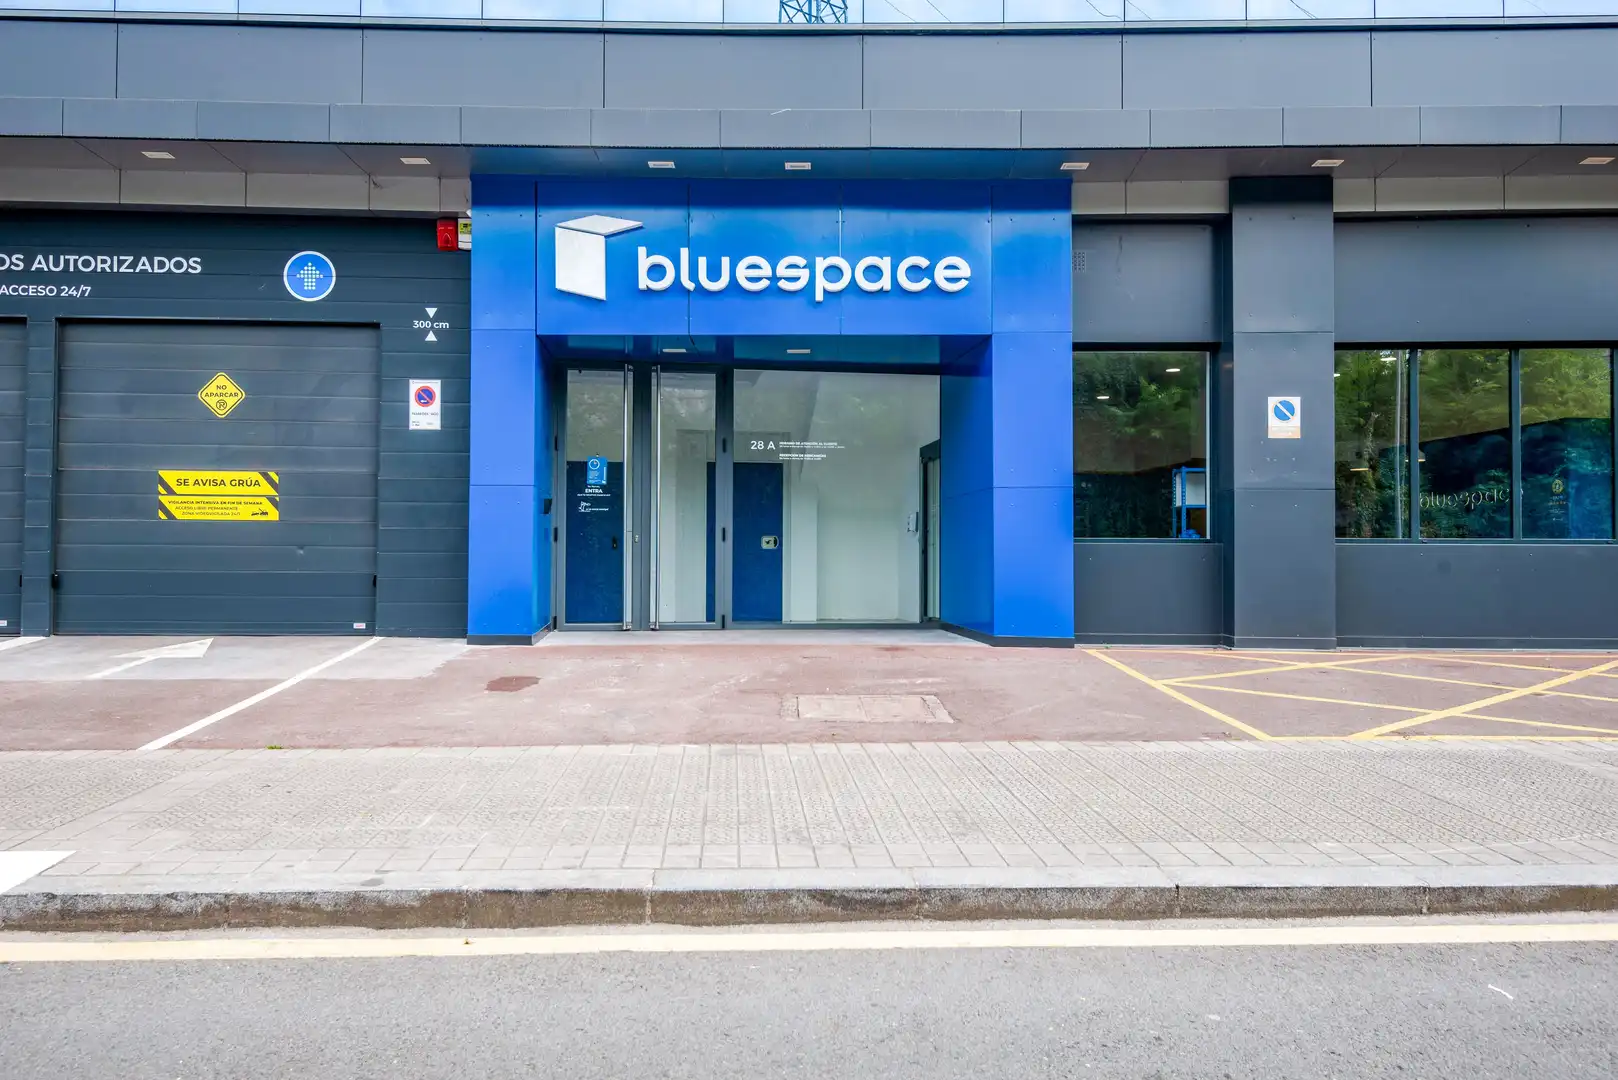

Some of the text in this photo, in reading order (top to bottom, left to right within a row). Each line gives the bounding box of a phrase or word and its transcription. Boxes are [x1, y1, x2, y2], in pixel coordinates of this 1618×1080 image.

[31, 254, 202, 274] AUTORIZADOS
[637, 246, 971, 303] bluespace
[0, 285, 91, 298] ACCESO 24/7
[412, 320, 449, 329] 300 cm
[750, 440, 776, 450] 28 A
[176, 477, 261, 488] SE AVISA GRÚA
